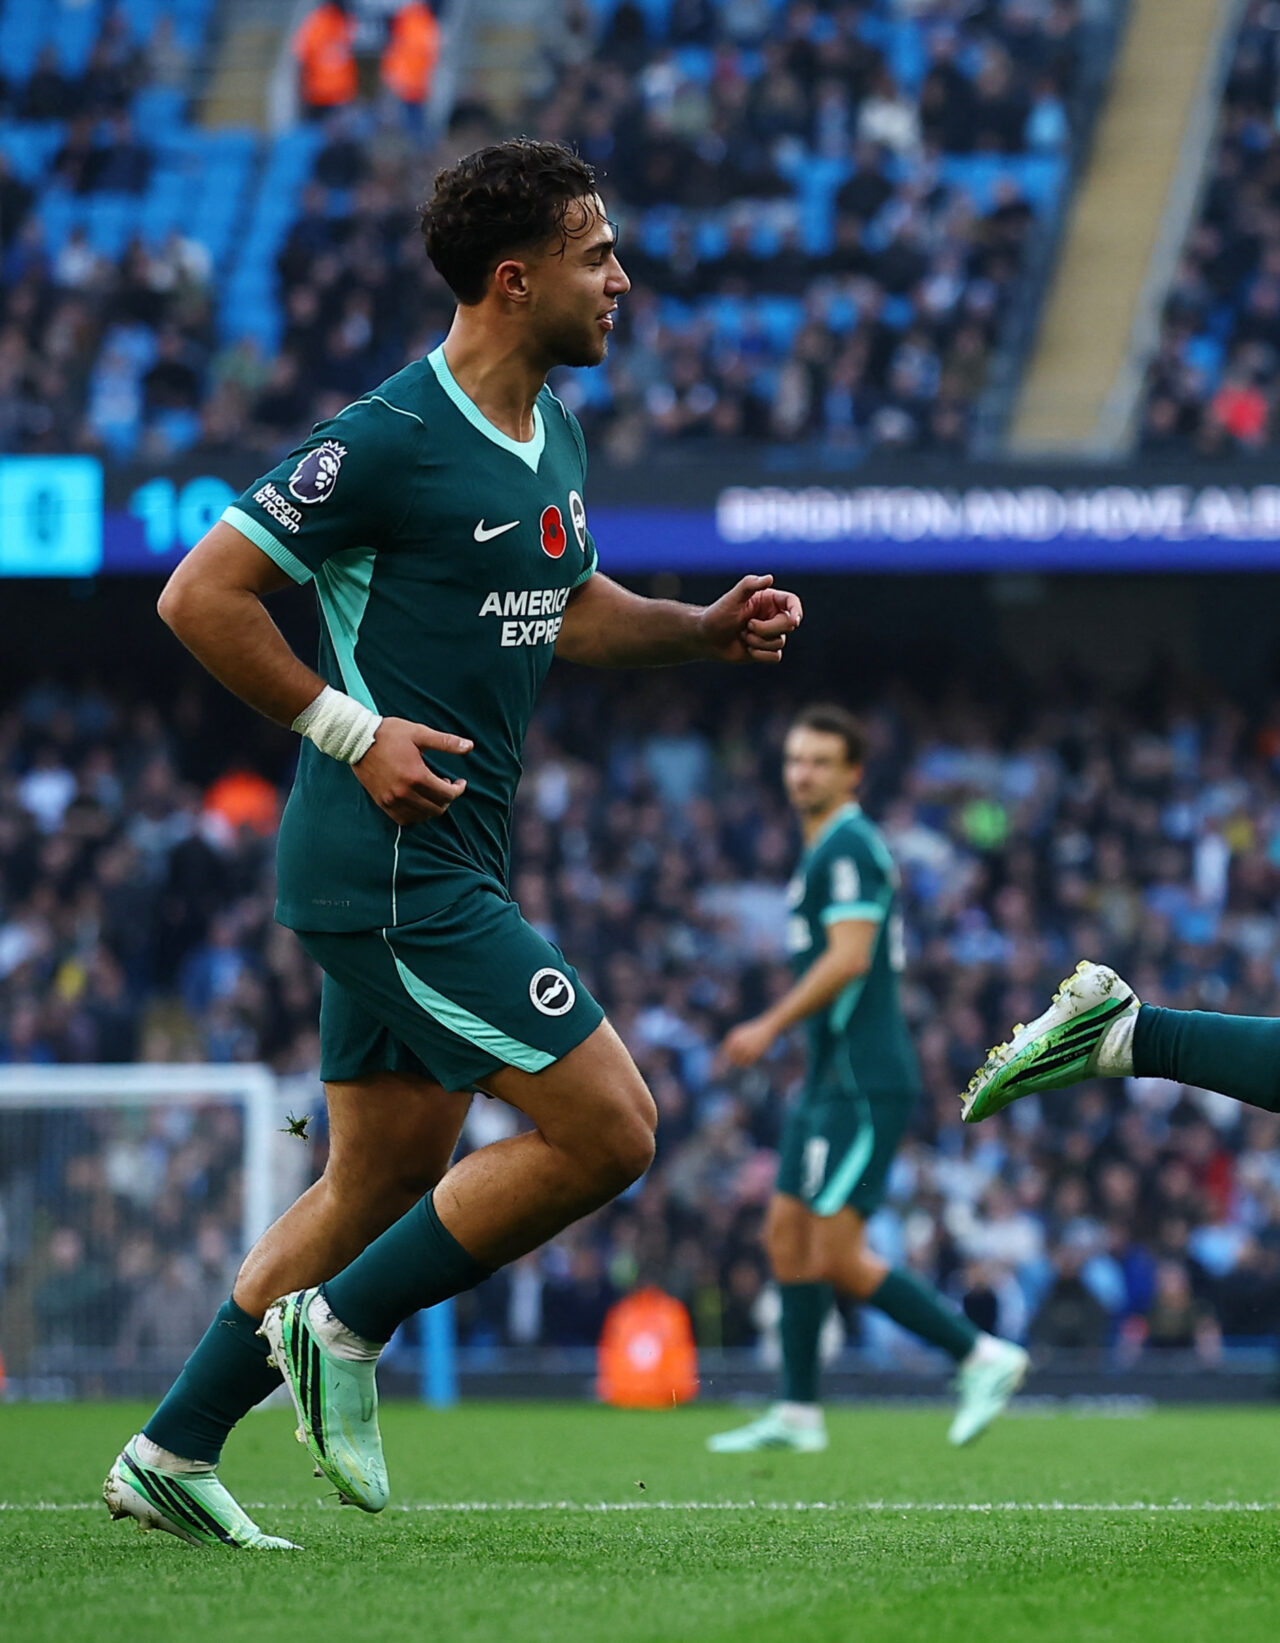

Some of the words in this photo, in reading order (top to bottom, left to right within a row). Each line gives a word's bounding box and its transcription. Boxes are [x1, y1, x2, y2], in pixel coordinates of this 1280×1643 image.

[260, 482, 276, 498] No
[272, 493, 302, 522] room
[263, 501, 300, 533] racism
